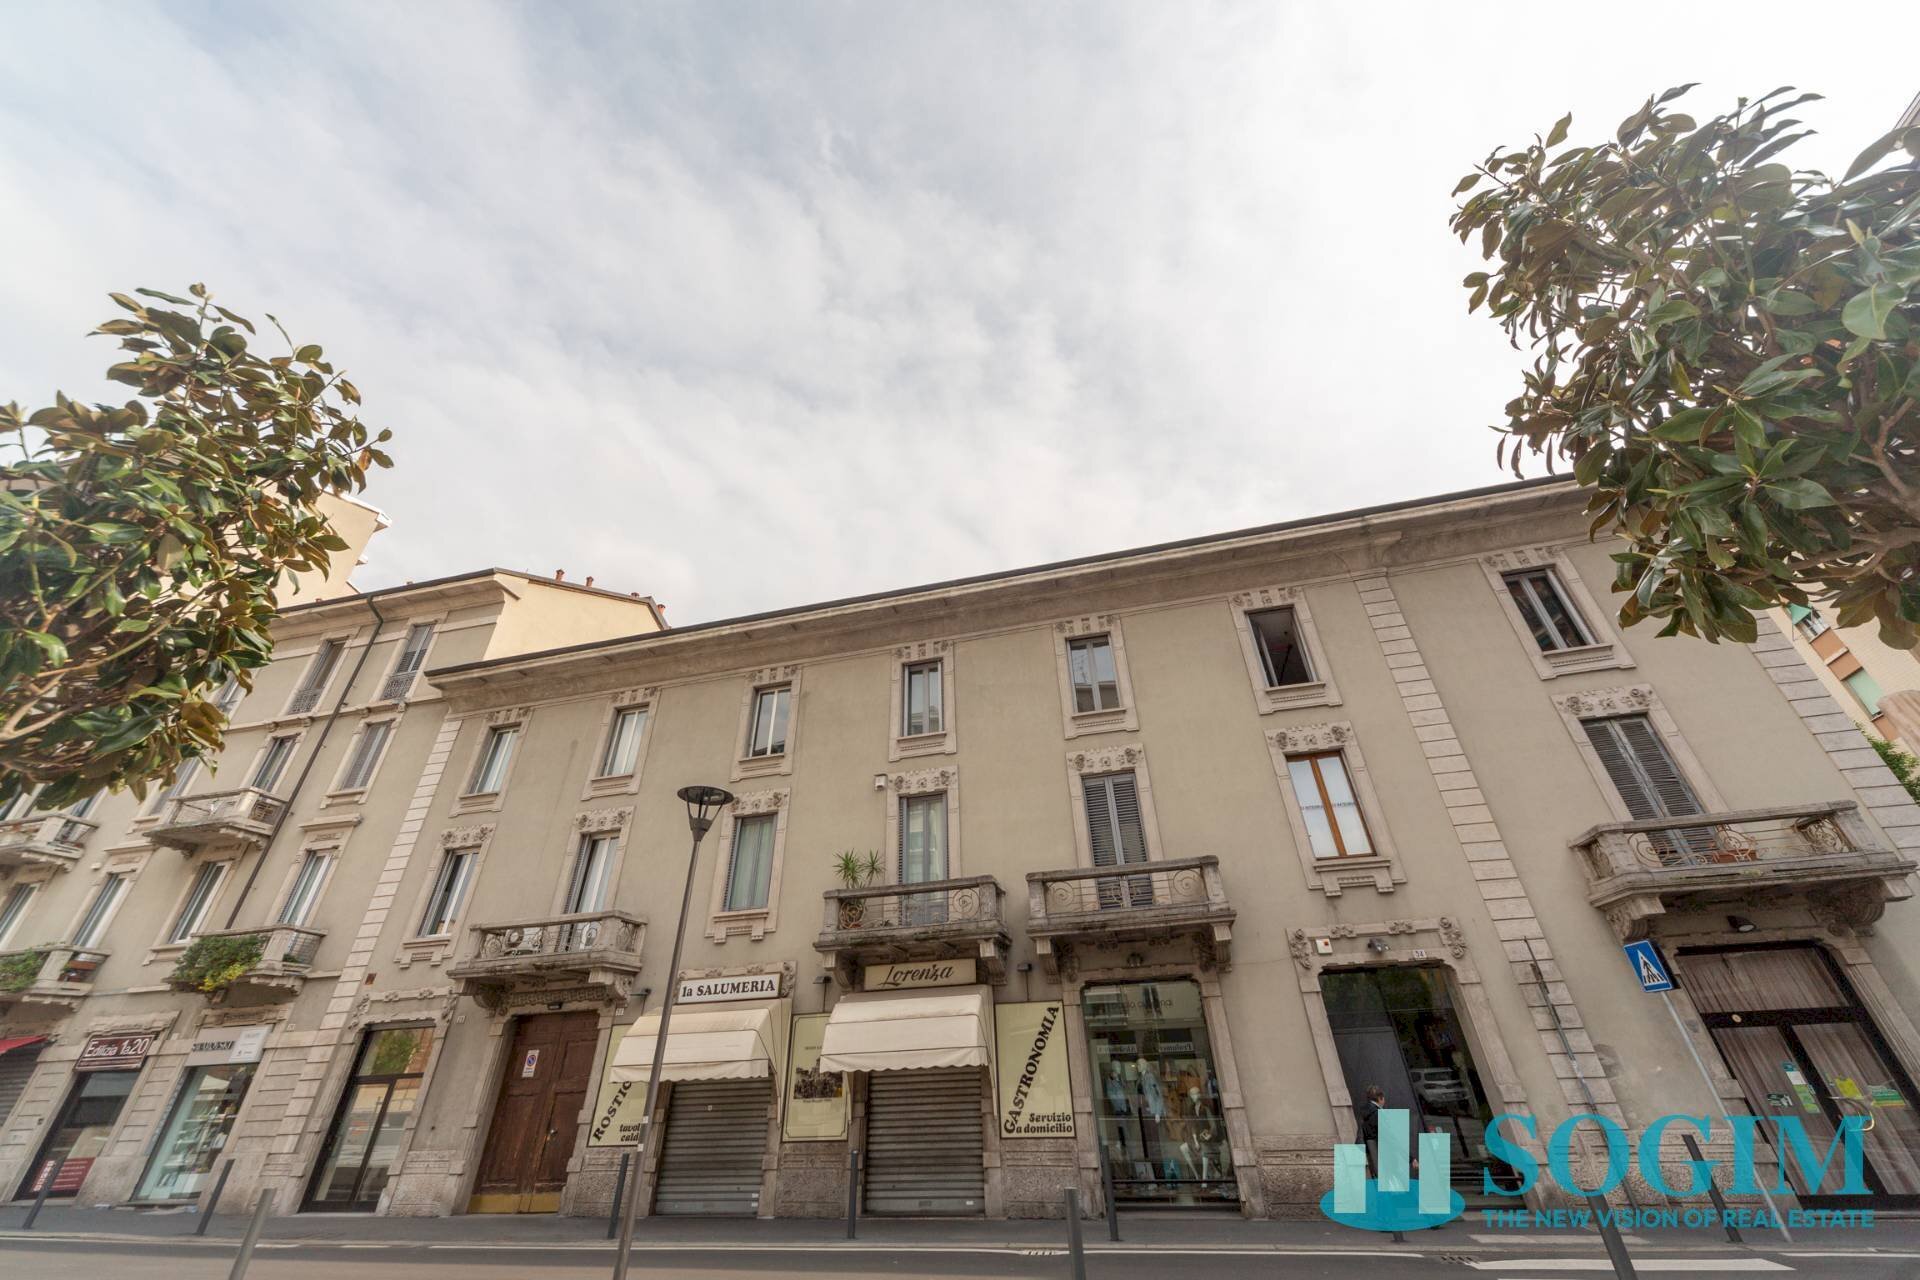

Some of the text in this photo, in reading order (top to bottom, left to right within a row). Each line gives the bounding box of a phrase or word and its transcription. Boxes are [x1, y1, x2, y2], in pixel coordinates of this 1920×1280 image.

[878, 964, 954, 989] Lorenza
[682, 979, 776, 998] la SALUMERIA
[1003, 1006, 1060, 1134] GASTRONOMIA
[1029, 1112, 1072, 1123] Servizio
[619, 1123, 641, 1132] tavol
[1015, 1123, 1073, 1134] a domicilio
[620, 1132, 640, 1142] cald
